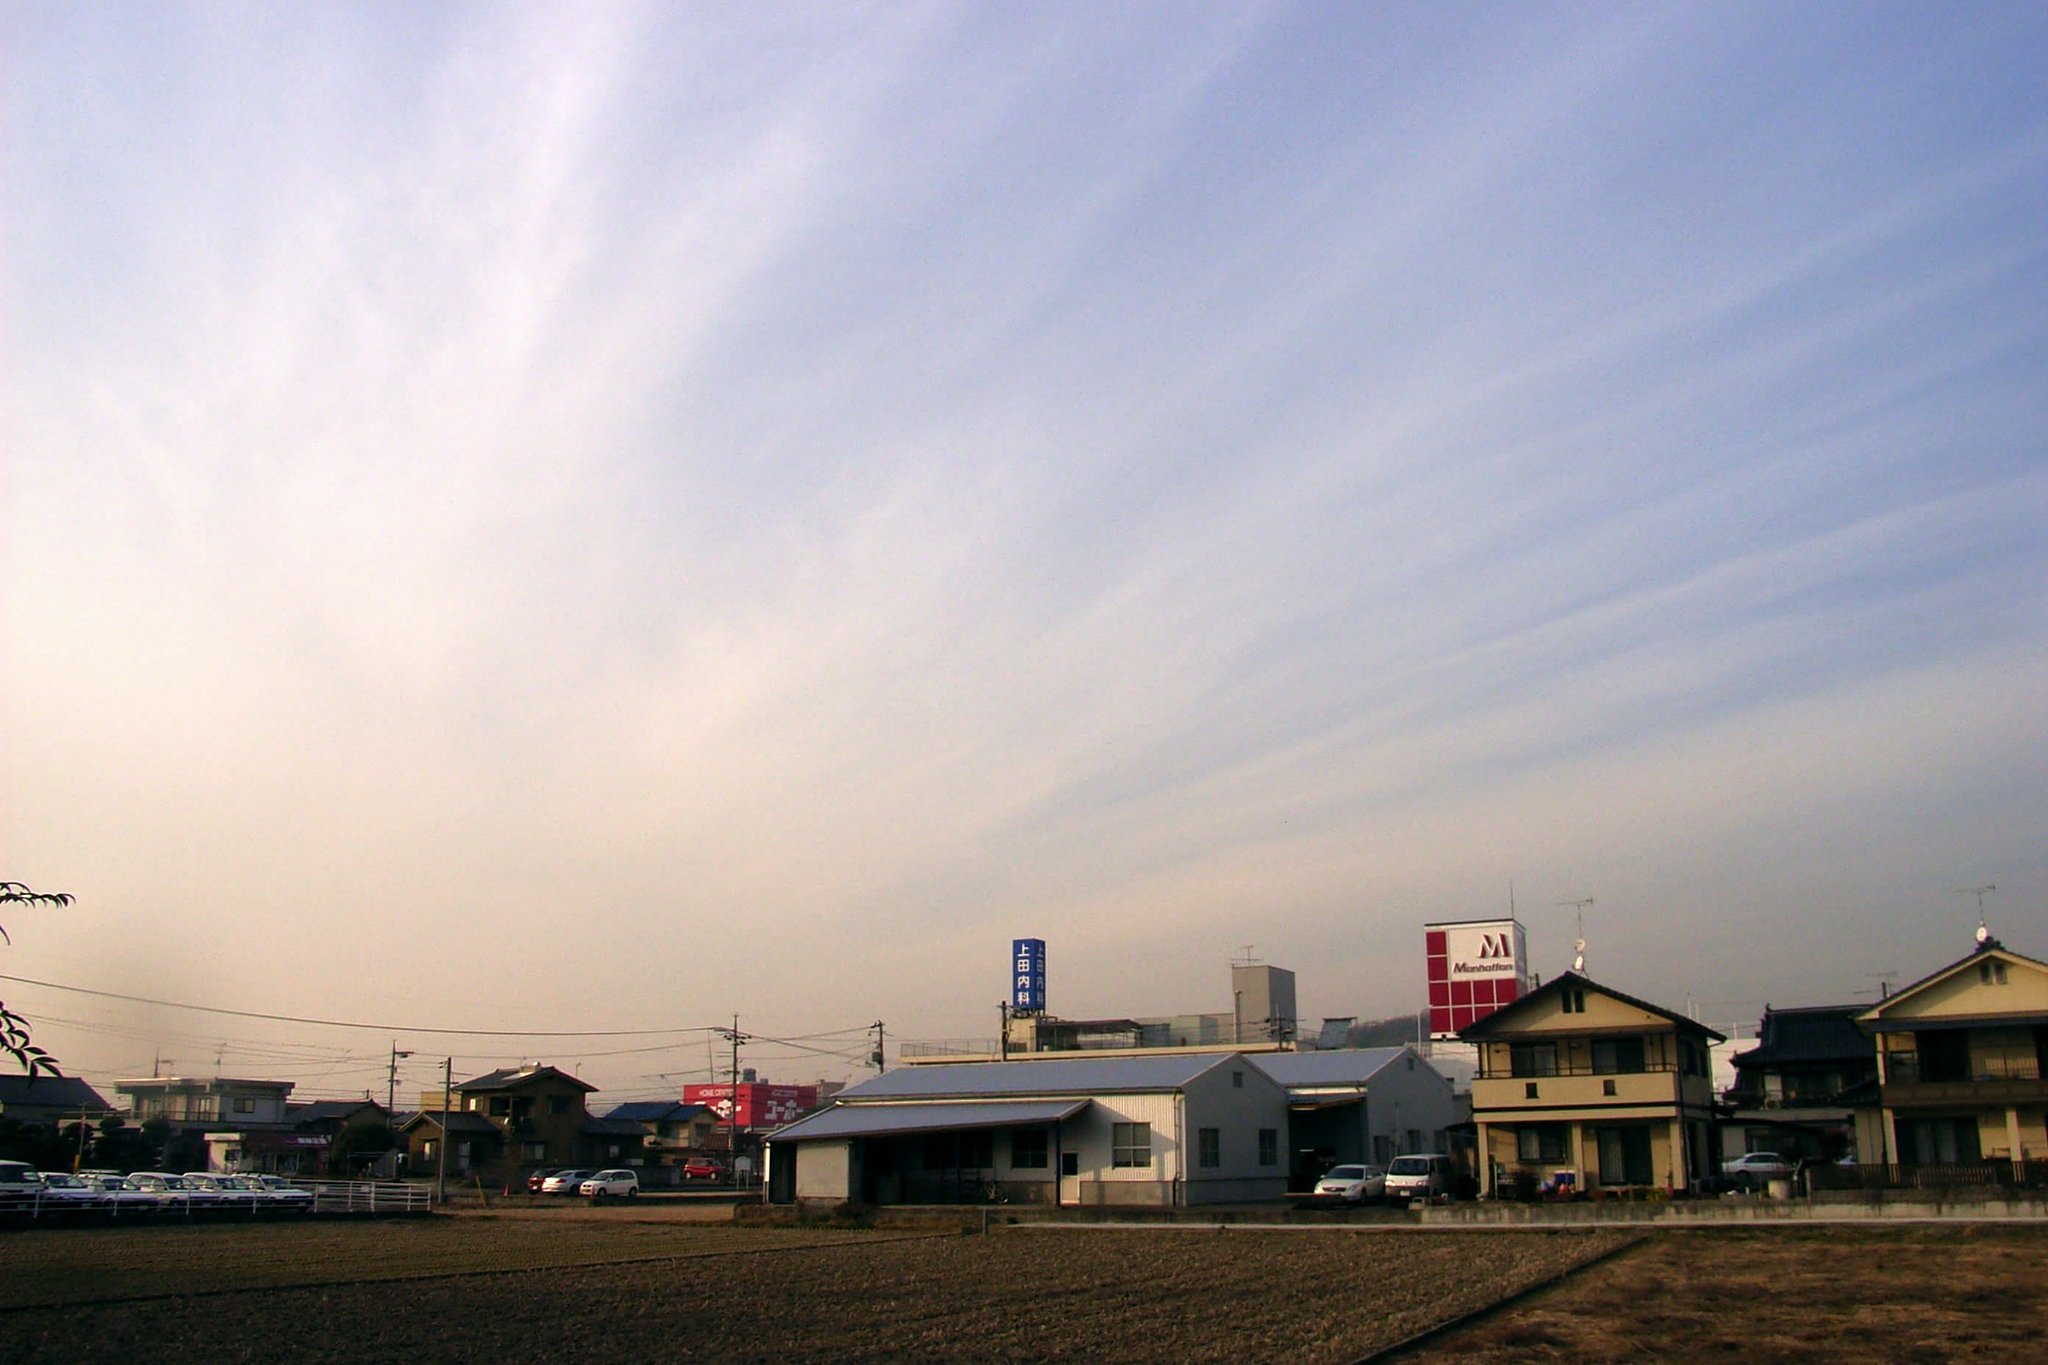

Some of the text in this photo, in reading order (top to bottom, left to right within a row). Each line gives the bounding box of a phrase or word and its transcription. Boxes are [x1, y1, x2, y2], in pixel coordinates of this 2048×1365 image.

[1017, 943, 1030, 1005] 上田内科
[1453, 961, 1513, 974] Manhattan
[699, 1088, 714, 1097] HOME
